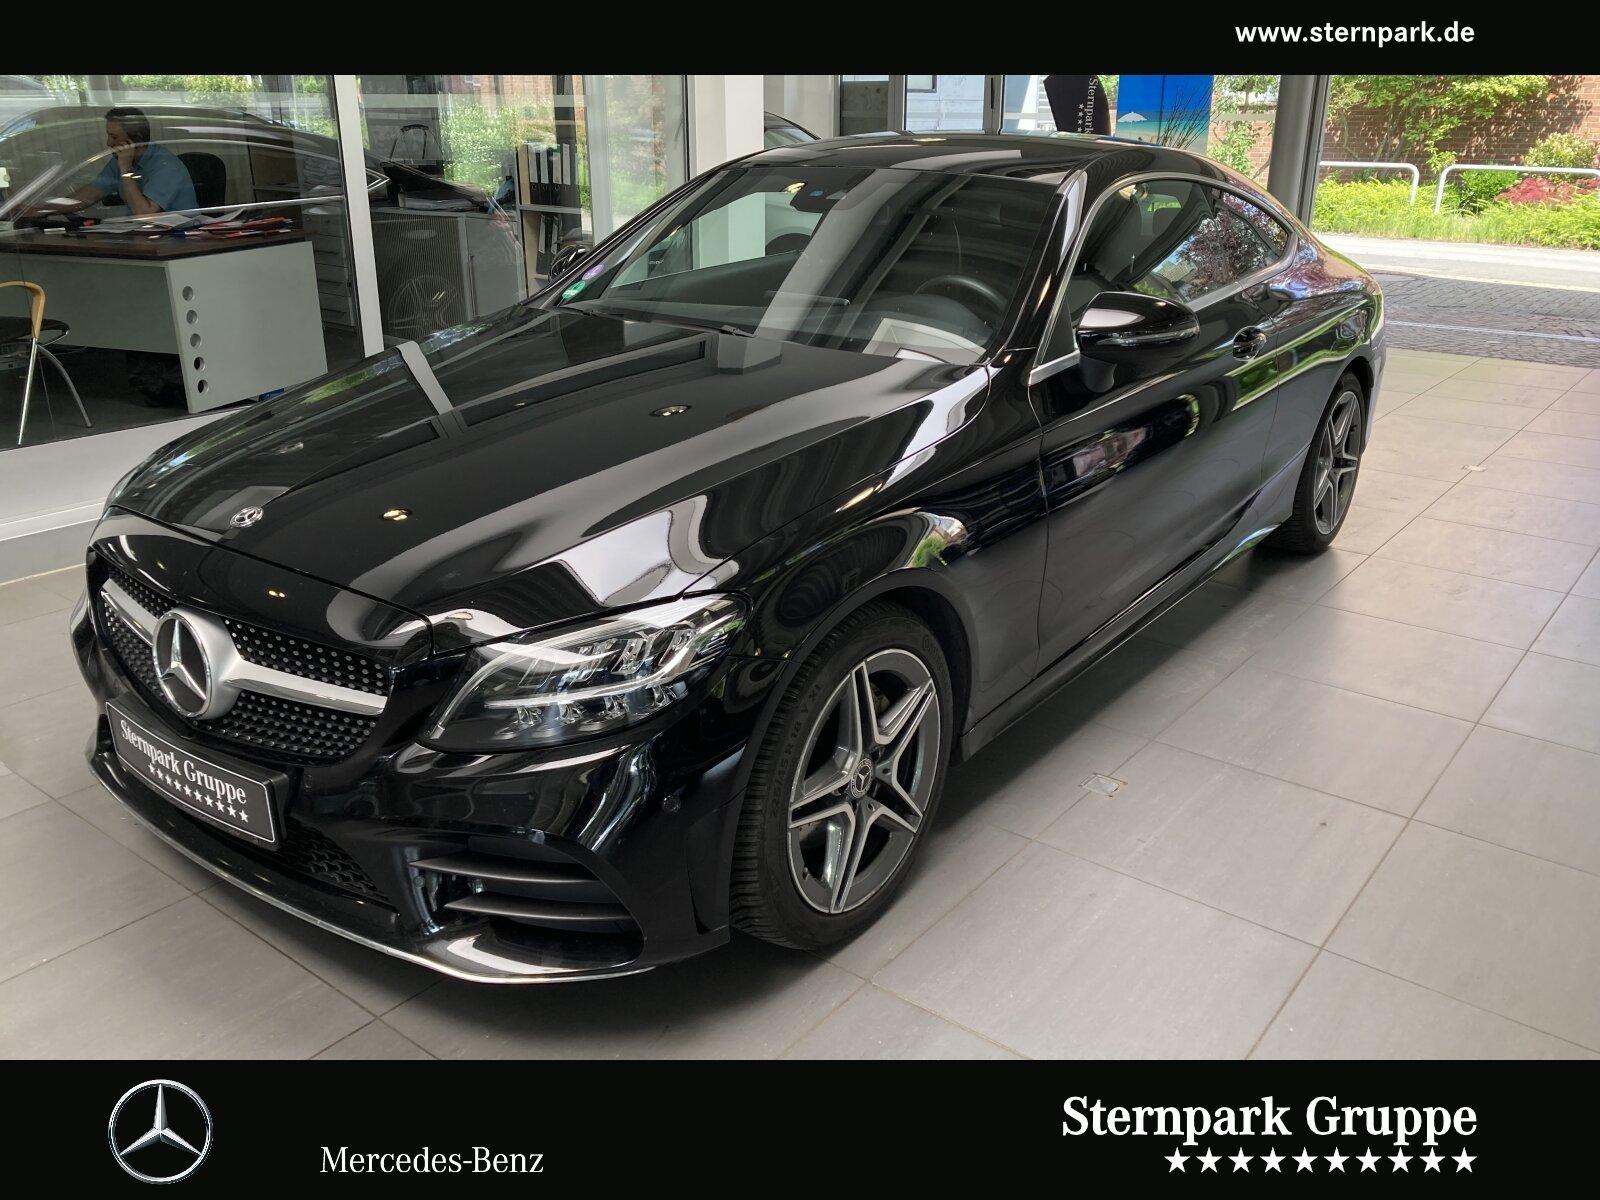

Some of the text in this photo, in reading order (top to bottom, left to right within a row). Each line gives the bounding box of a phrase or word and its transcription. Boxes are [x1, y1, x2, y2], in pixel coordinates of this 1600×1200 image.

[1083, 77, 1099, 135] Sternpark
[120, 719, 247, 805] Sternpark Gruppe
